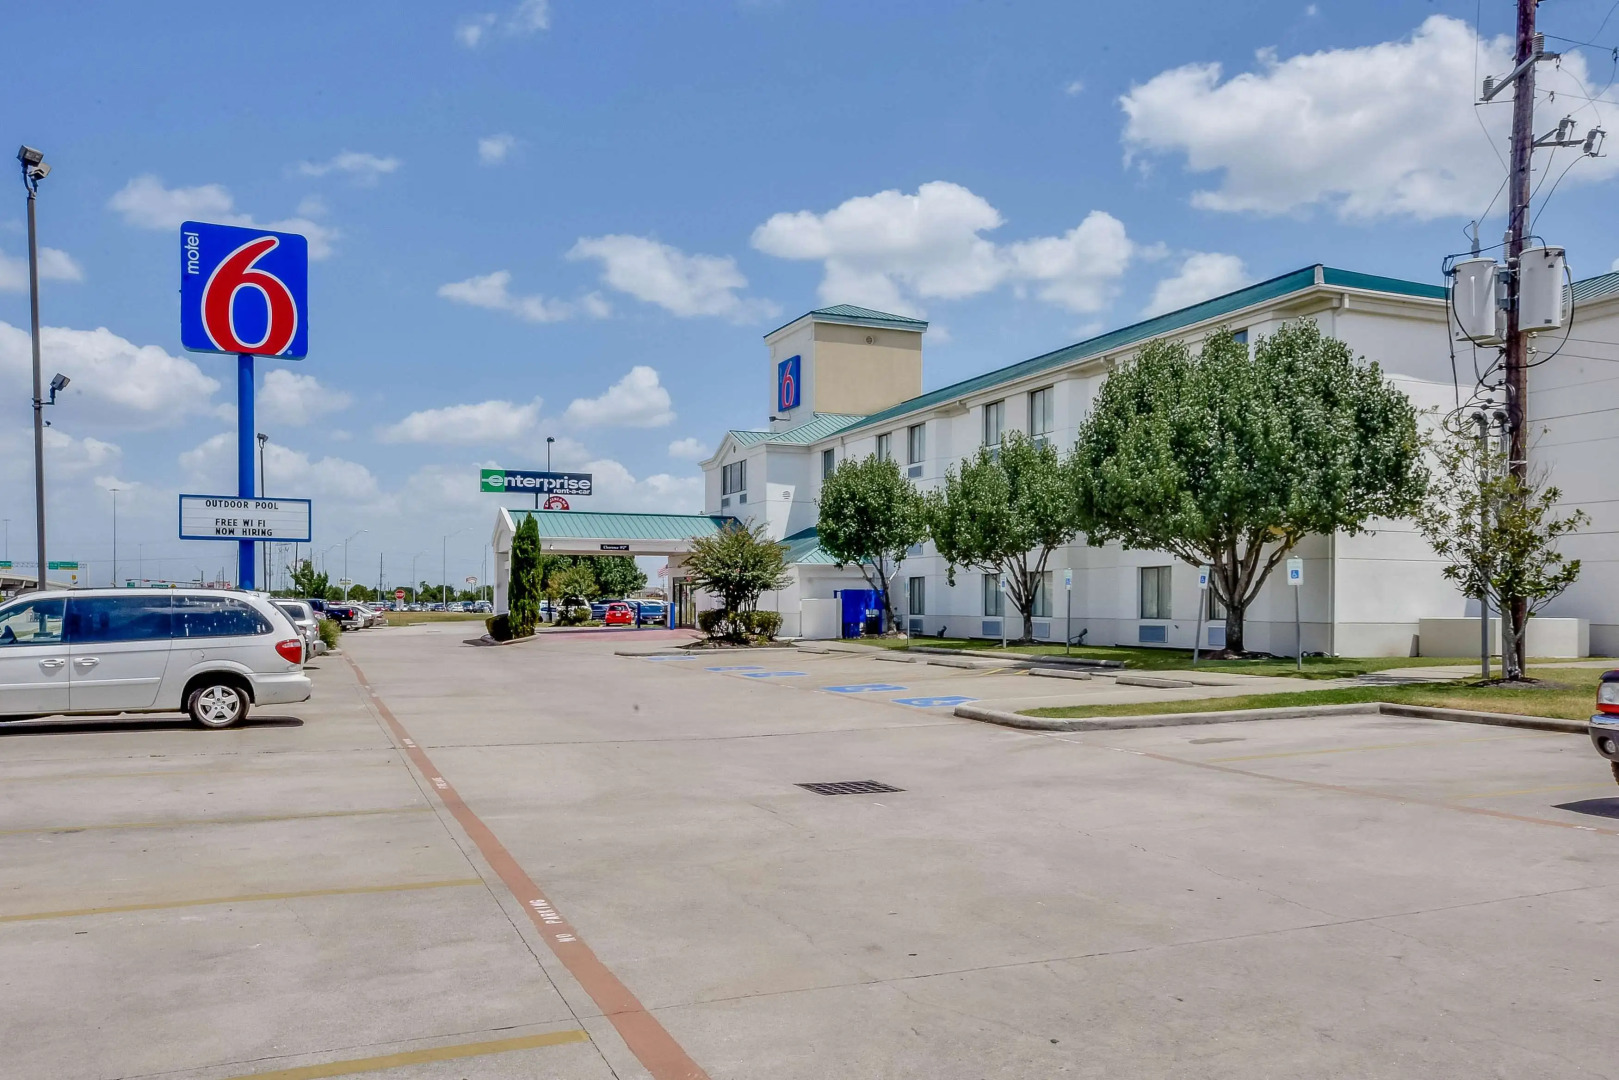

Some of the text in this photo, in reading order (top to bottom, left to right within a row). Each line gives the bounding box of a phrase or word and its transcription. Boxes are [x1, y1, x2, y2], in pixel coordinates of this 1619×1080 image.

[183, 231, 298, 355] motel 6
[781, 360, 795, 408] 6
[206, 500, 248, 508] OUTDOOR
[487, 475, 591, 491] enterprise
[529, 899, 577, 943] NO PARKING
